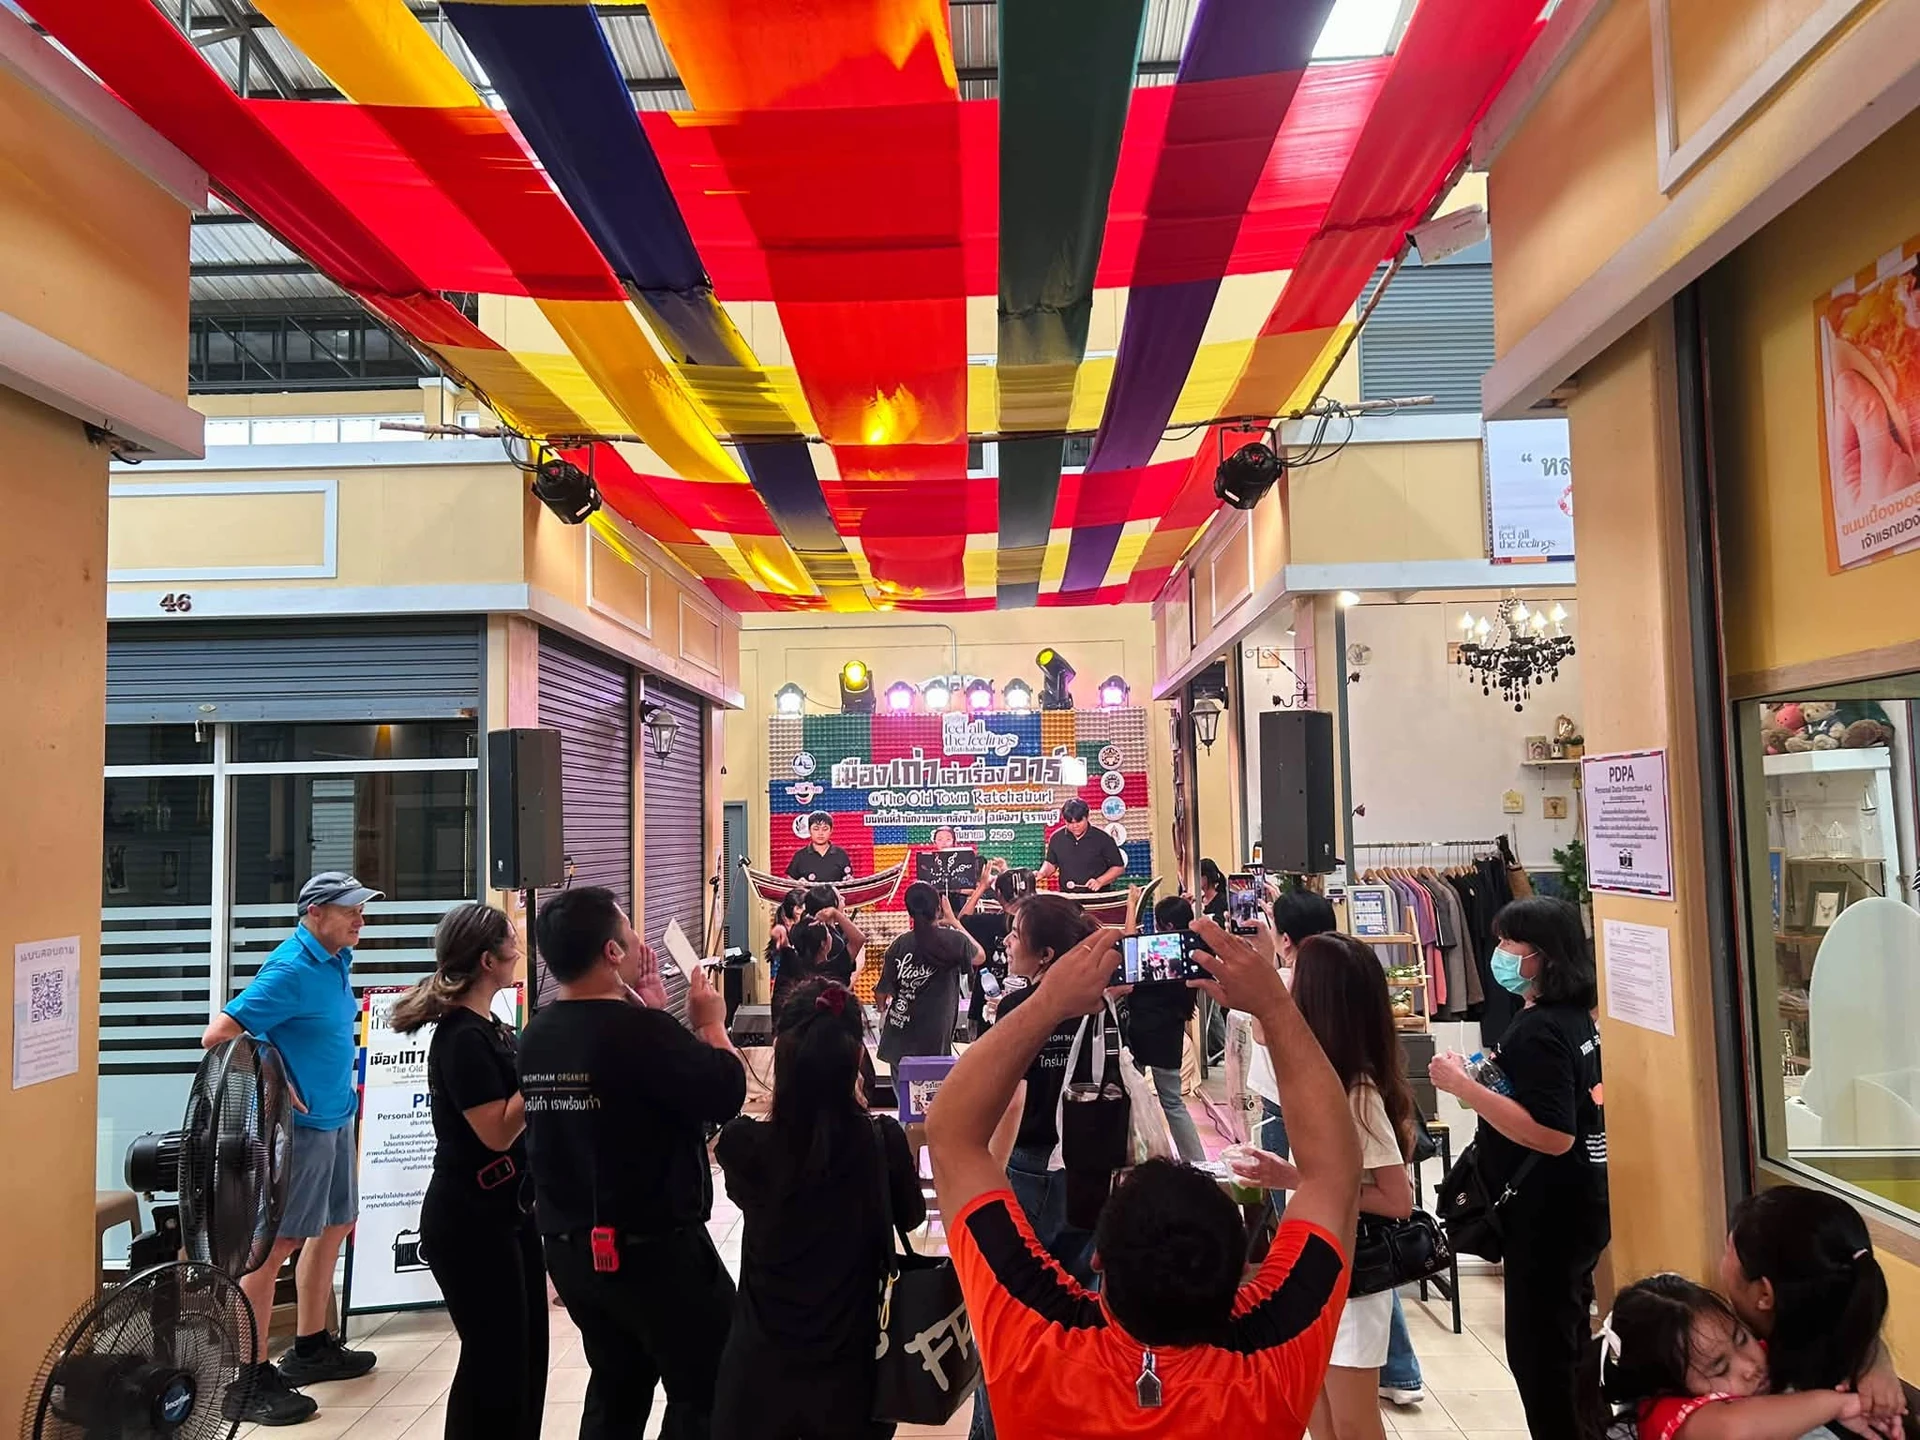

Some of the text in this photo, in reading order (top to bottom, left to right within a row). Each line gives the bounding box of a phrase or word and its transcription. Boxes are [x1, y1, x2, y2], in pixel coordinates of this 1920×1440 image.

[1499, 529, 1530, 540] feel all
[1861, 508, 1920, 549] เจ้าแรกของ
[1499, 539, 1556, 554] the feelings
[159, 593, 192, 612] 46
[969, 721, 983, 734] all
[945, 734, 965, 746] the
[1609, 764, 1635, 782] PDPA
[908, 791, 932, 805] Old
[936, 790, 969, 804] Town
[991, 830, 1013, 840] 2569
[377, 1110, 432, 1120] Personal Dat
